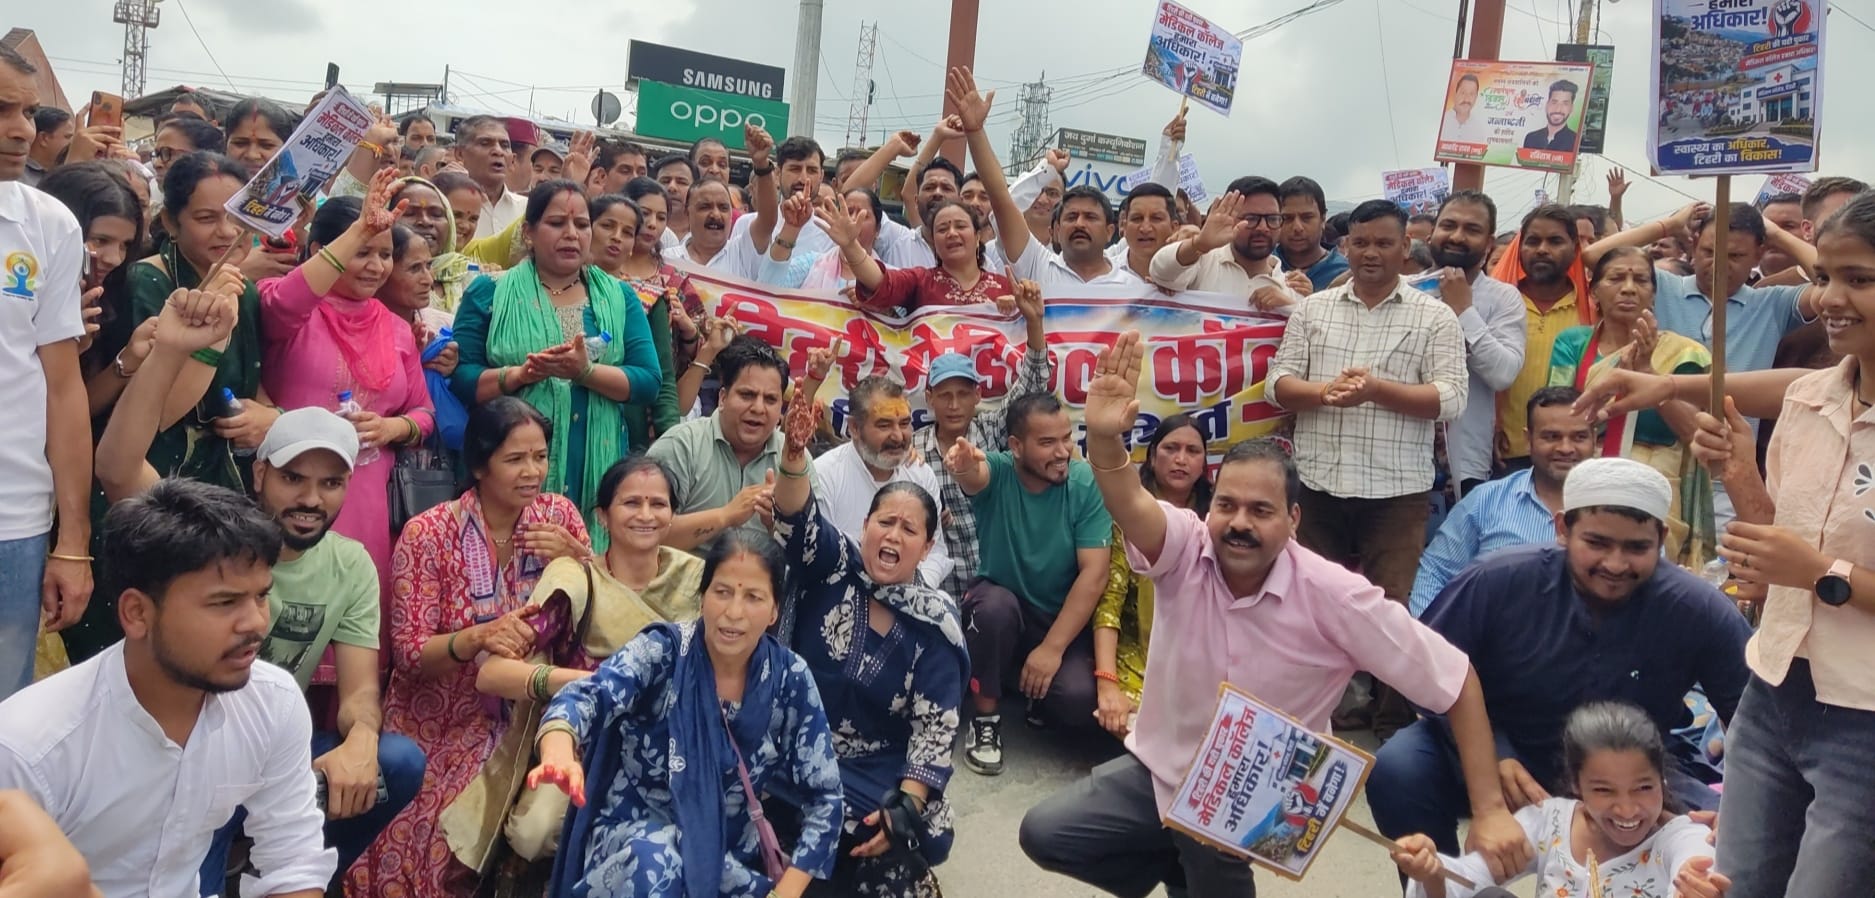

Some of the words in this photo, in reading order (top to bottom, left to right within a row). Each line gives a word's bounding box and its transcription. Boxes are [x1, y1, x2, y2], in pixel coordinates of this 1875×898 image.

[1159, 13, 1195, 37] मेडिकल
[1196, 31, 1225, 50] कॉलेज
[1691, 7, 1768, 30] अधिकार!
[1155, 35, 1206, 63] अधिकार!
[1173, 32, 1197, 47] हमारा
[682, 68, 773, 99] SAMSUNG
[670, 101, 766, 131] oppo
[1694, 153, 1722, 165] टिहरी
[1724, 153, 1738, 163] का
[1740, 149, 1782, 162] विकास!
[1712, 143, 1725, 152] का
[1198, 762, 1235, 826] मेडिकल
[1228, 706, 1257, 760] कॉलेज
[1226, 755, 1251, 800] हमारा
[1225, 740, 1271, 832] अधिकार!
[1296, 816, 1321, 853] टिहरी
[1315, 802, 1328, 817] में
[1323, 766, 1344, 803] बनेगा!
